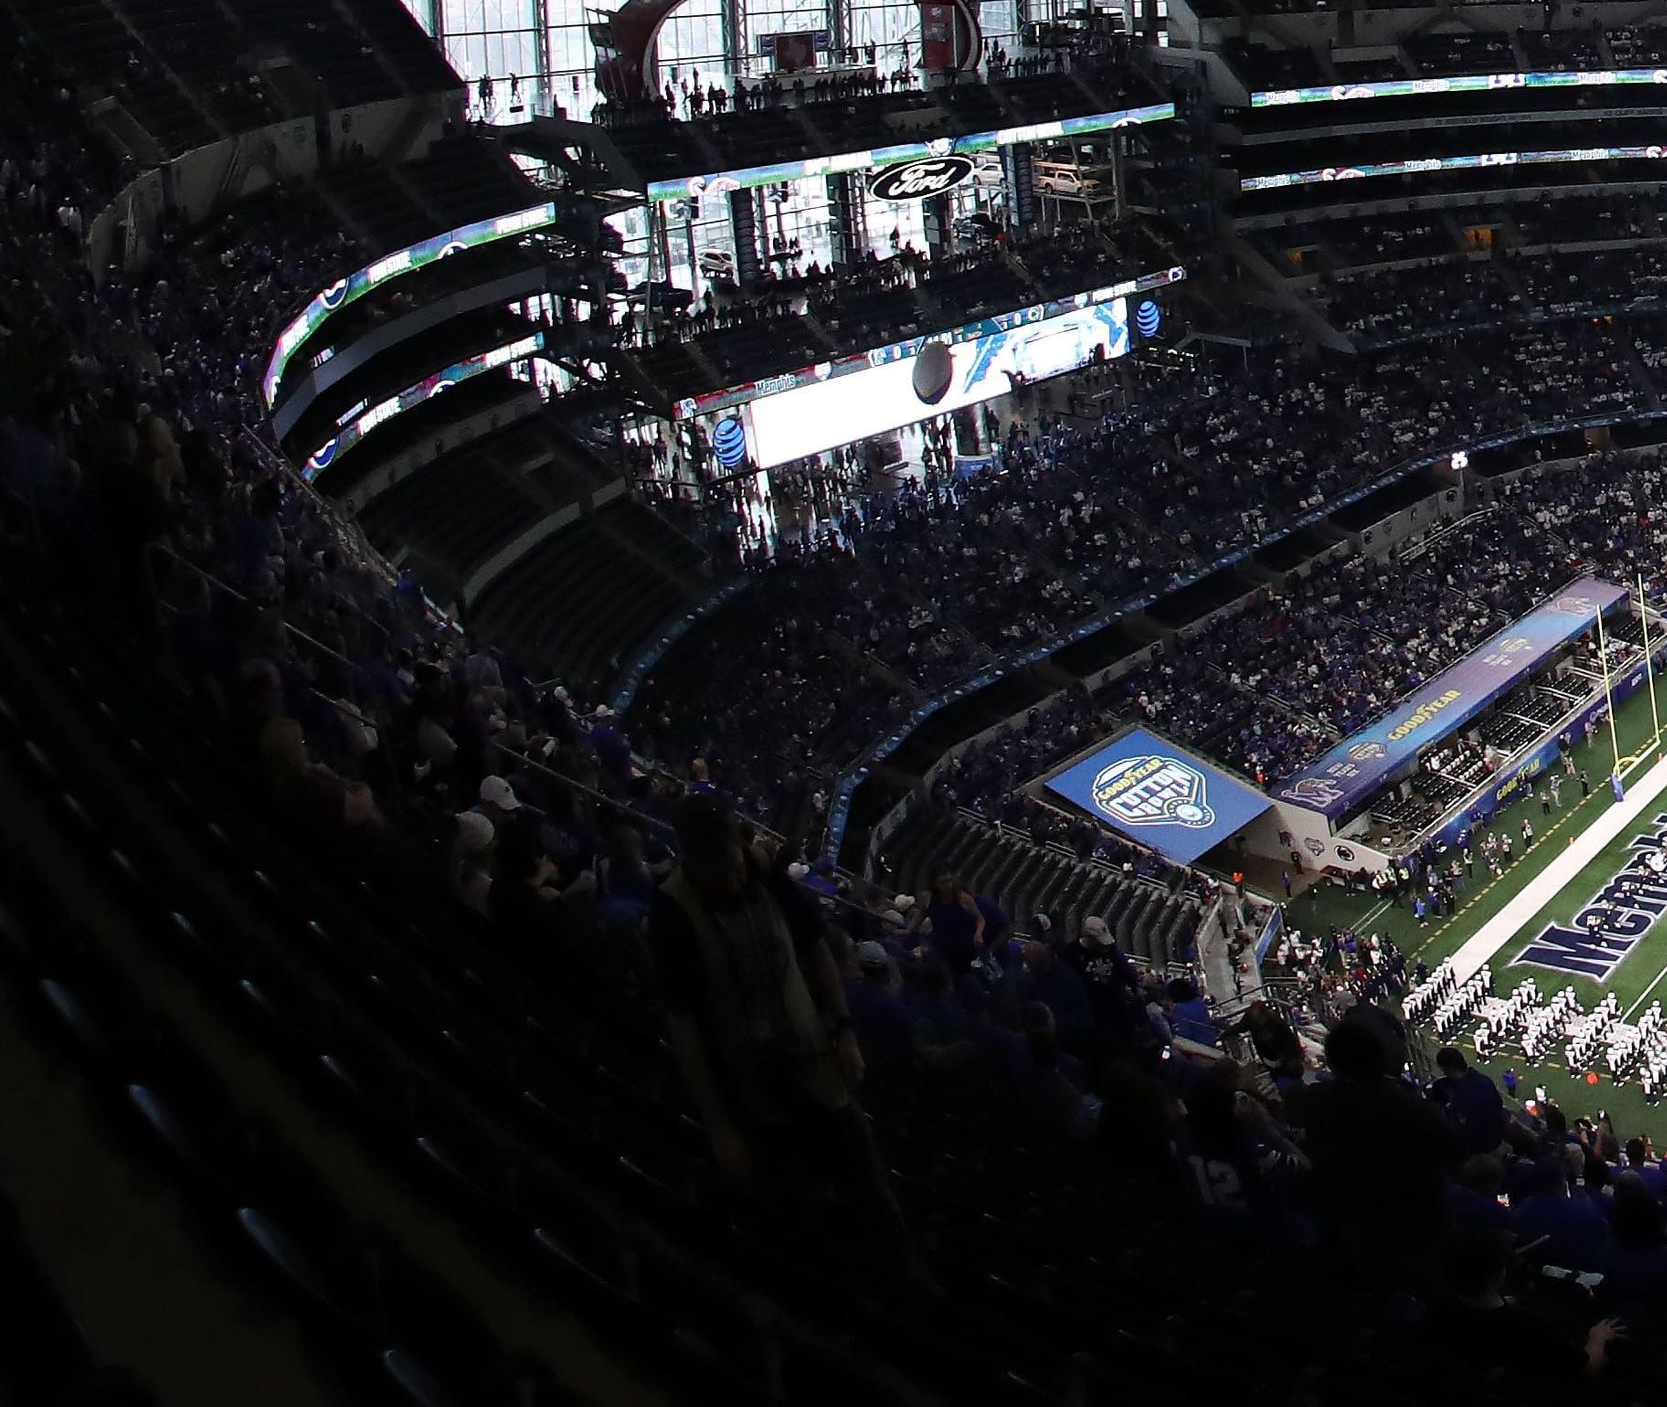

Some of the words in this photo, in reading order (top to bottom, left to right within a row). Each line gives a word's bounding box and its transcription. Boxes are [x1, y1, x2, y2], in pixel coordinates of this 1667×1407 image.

[892, 161, 953, 194] Ford
[756, 373, 796, 397] Memphis
[1387, 689, 1462, 740] GOODYEAR
[1098, 758, 1163, 800] GOODYEAR
[1109, 764, 1192, 817] COTTON
[1140, 779, 1193, 816] BOWL
